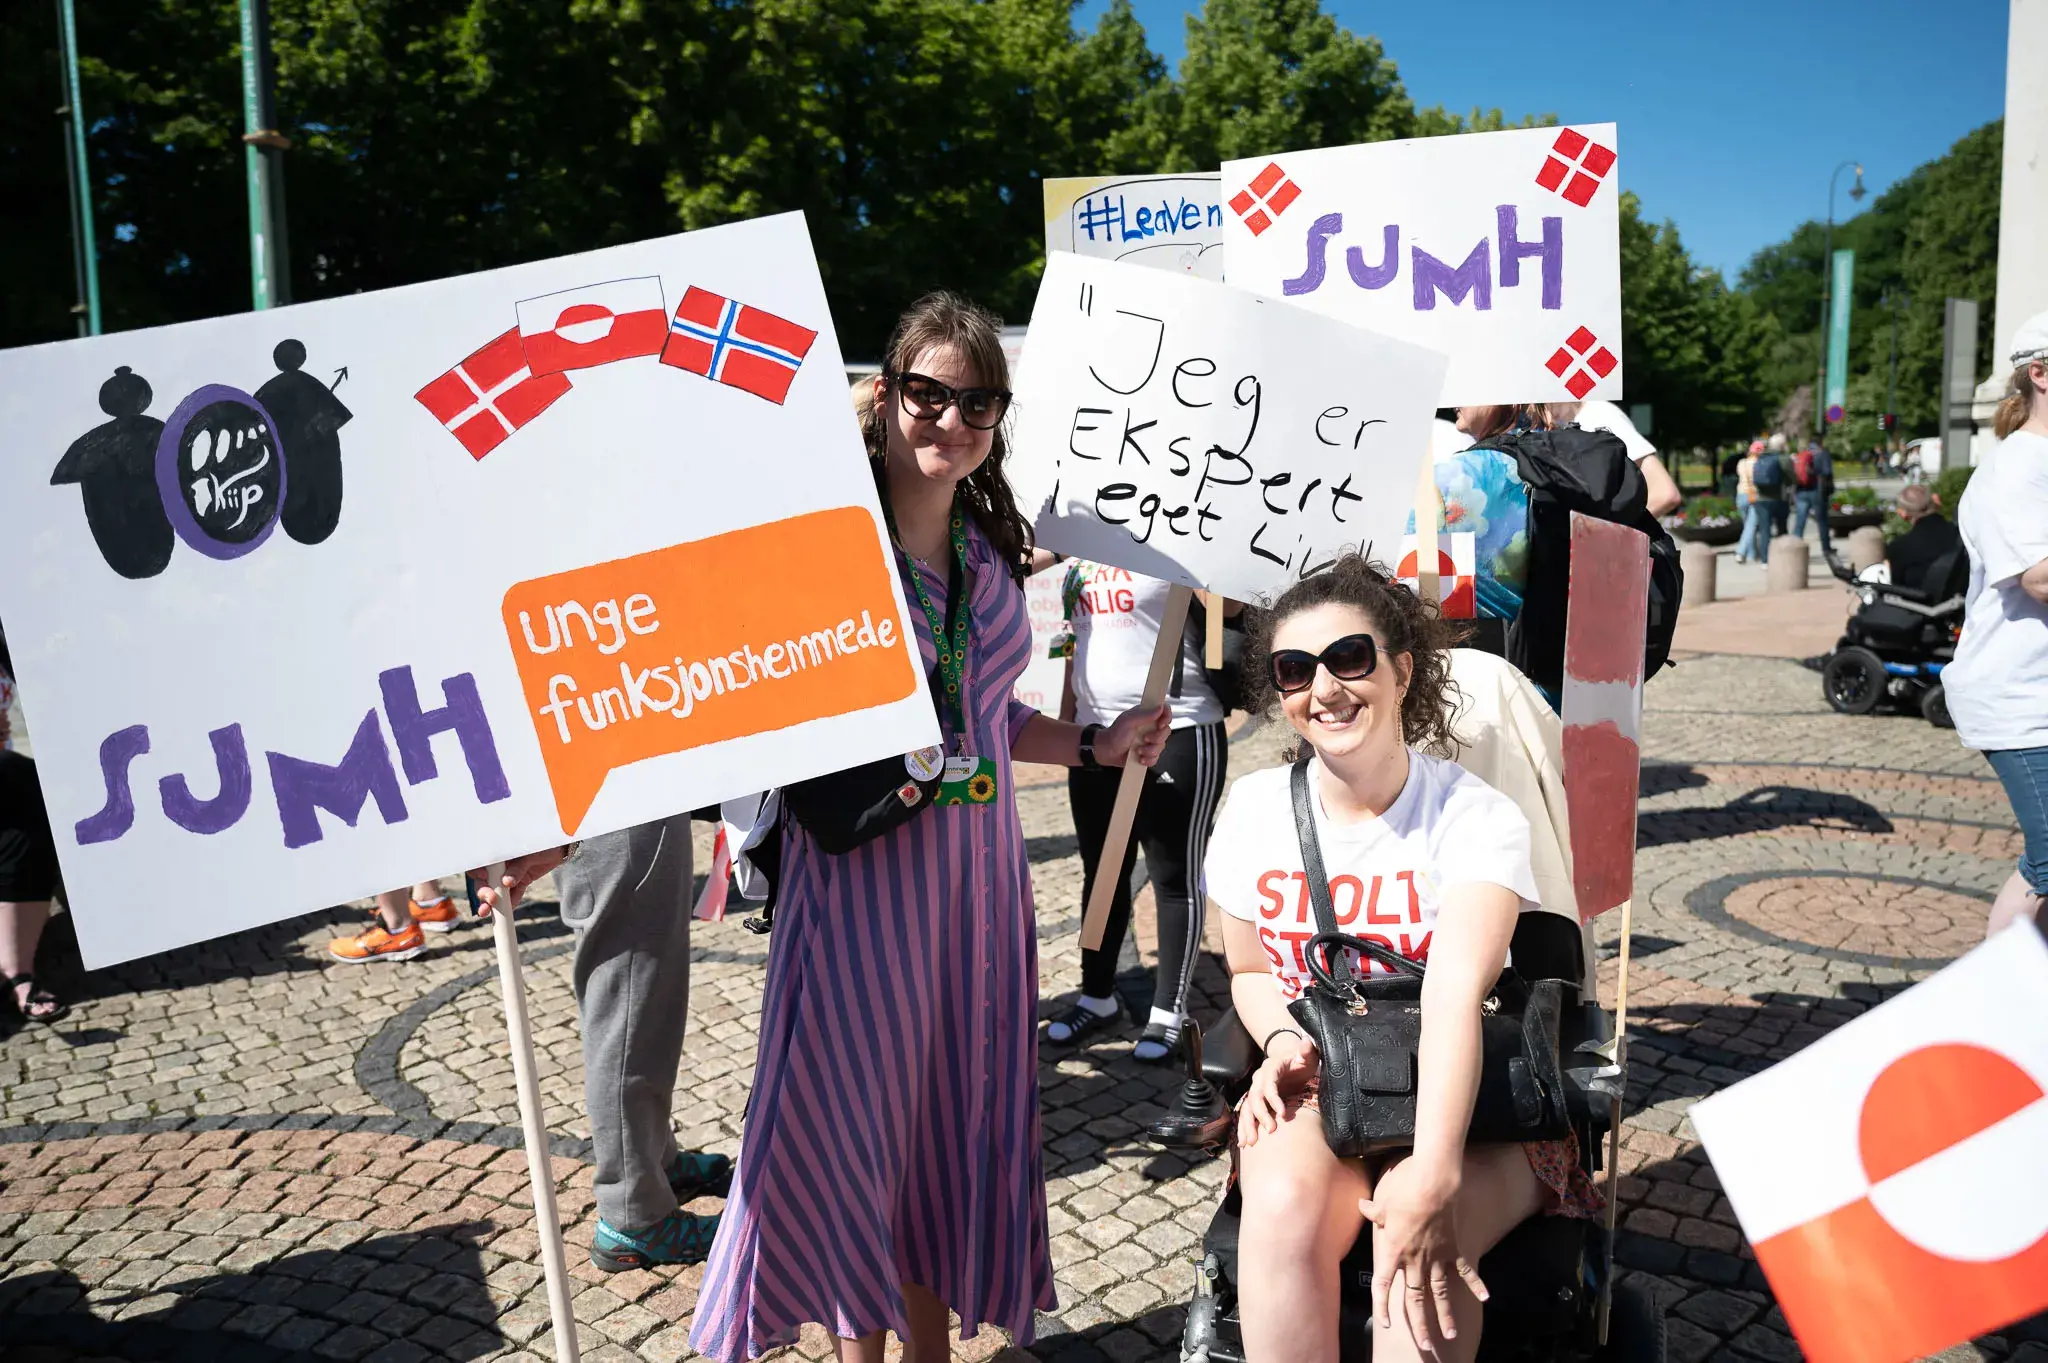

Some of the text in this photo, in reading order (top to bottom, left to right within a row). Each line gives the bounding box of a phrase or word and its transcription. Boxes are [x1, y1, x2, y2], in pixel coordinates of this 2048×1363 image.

[1283, 204, 1563, 310] SUMH
[1315, 405, 1388, 450] er
[1095, 481, 1222, 544] eget
[518, 593, 660, 655] unge
[539, 610, 898, 744] funksjonshemmede
[75, 664, 511, 849] SUMH
[1256, 869, 1422, 926] STOLT
